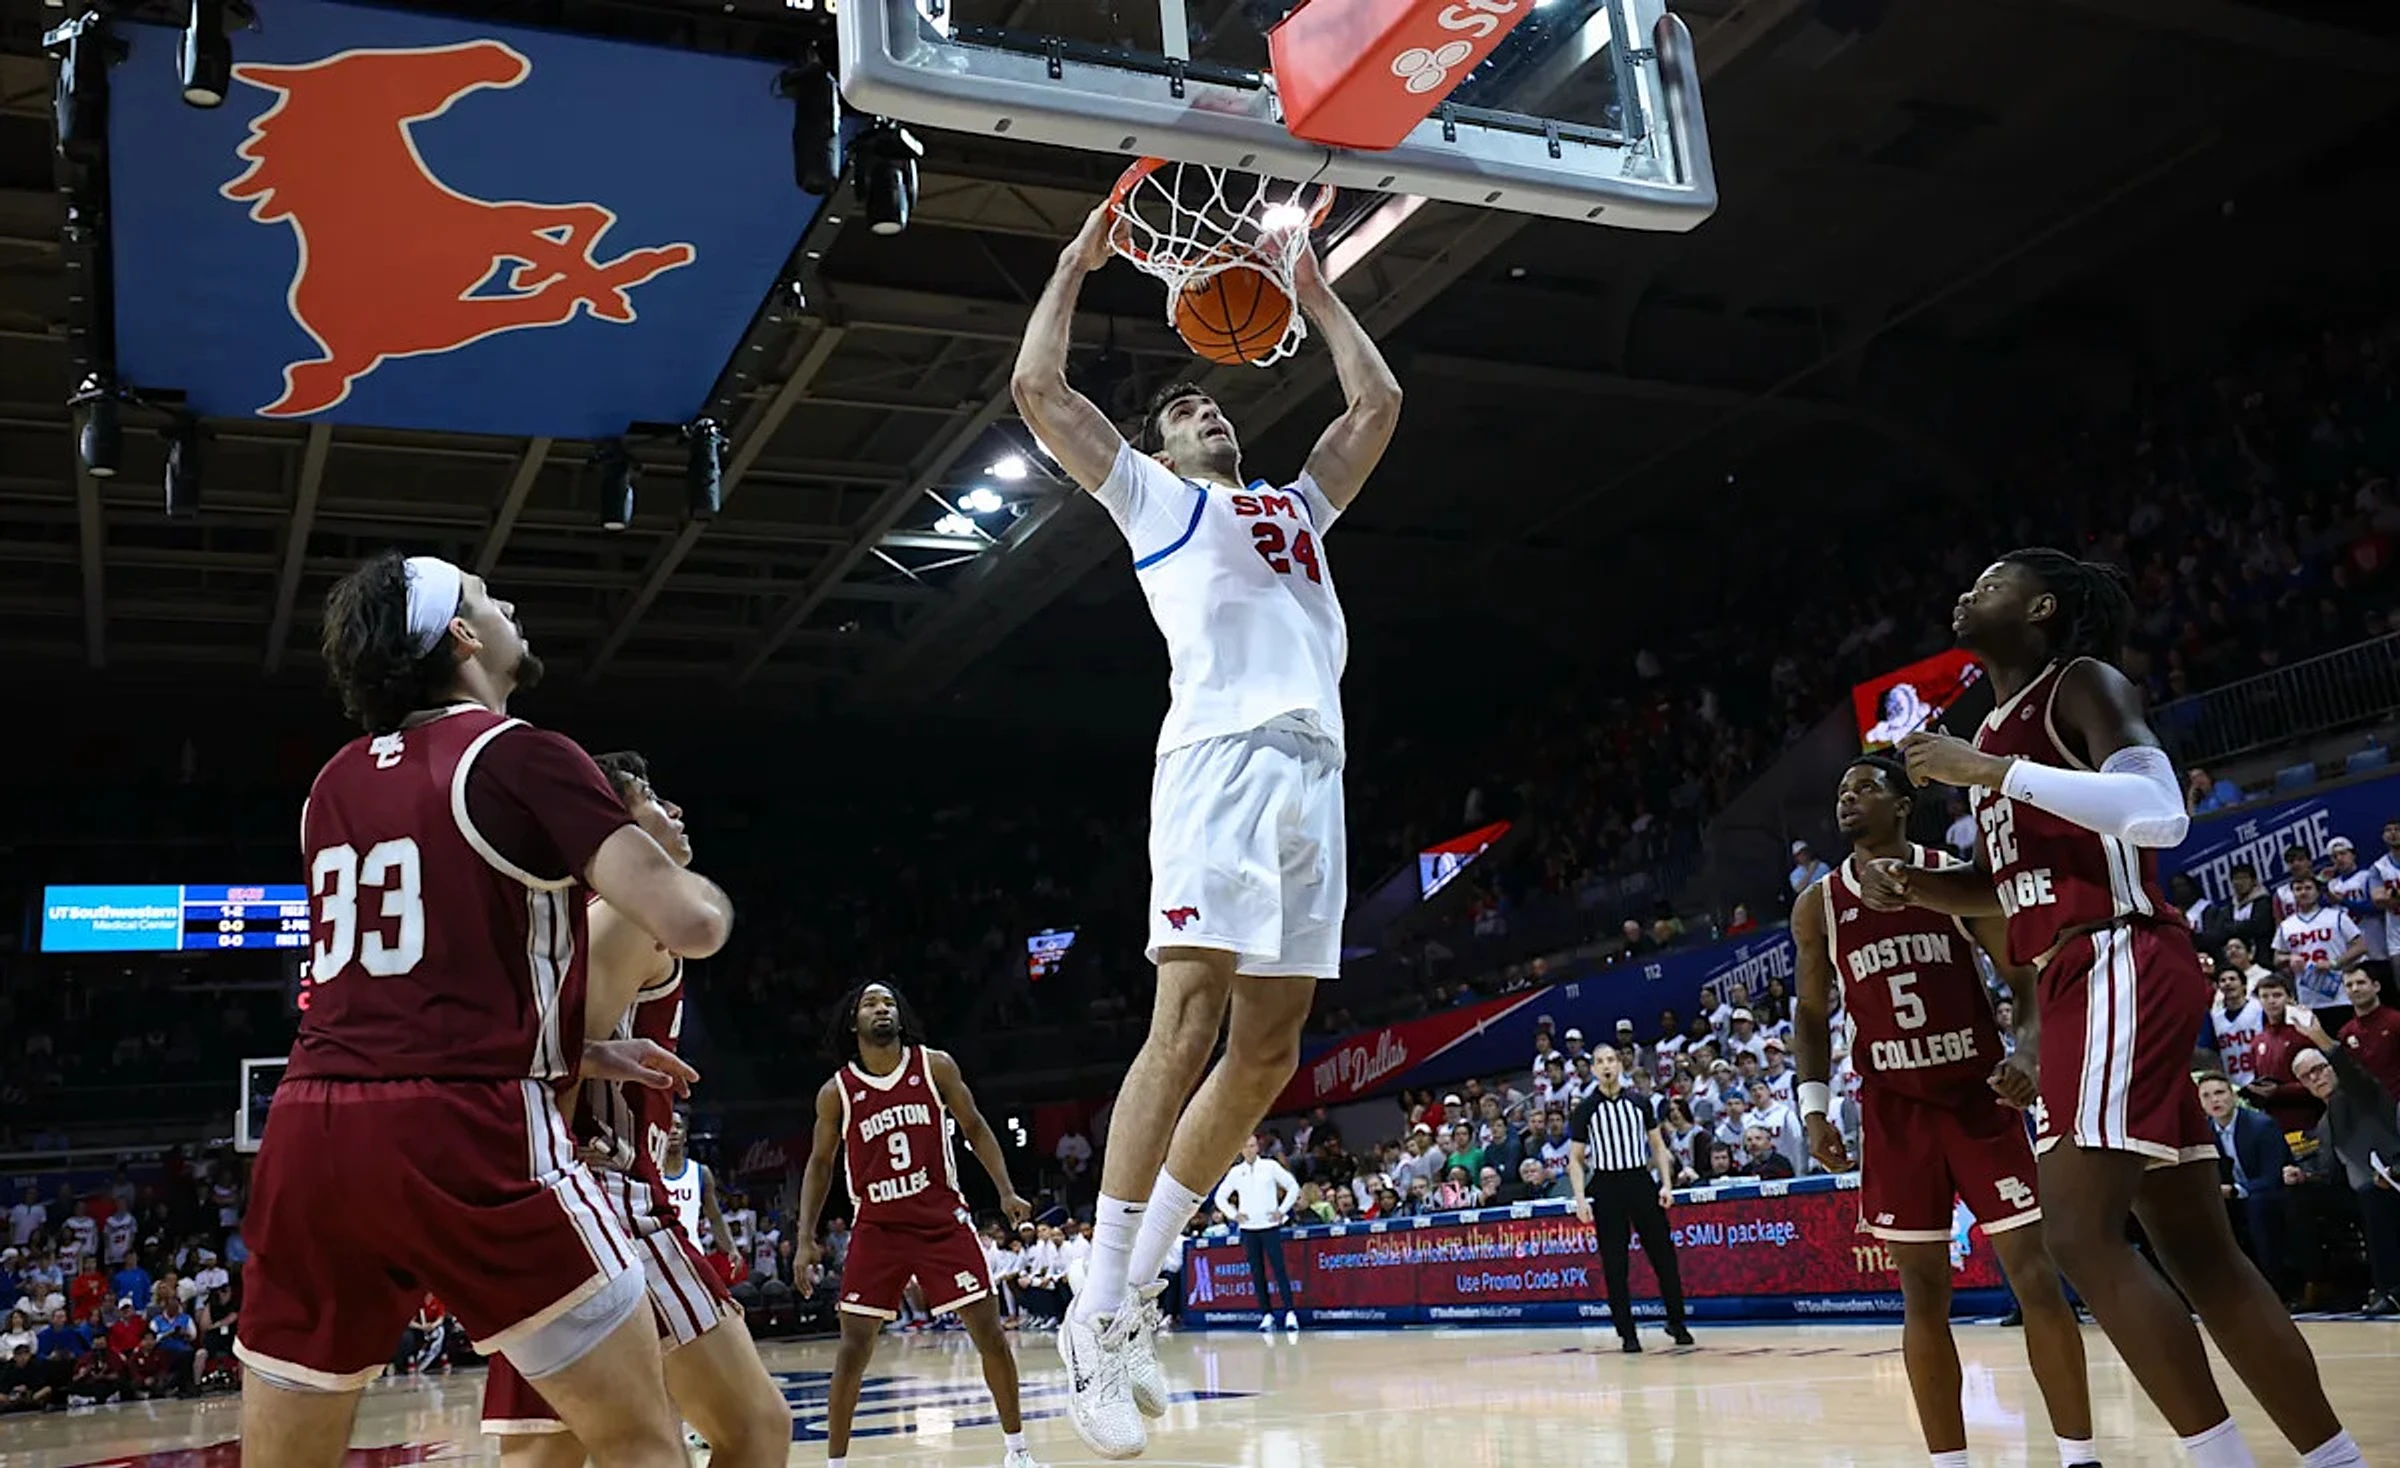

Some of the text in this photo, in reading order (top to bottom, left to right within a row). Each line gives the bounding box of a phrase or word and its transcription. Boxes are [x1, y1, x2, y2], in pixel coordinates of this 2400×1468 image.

[1231, 494, 1298, 519] SM
[1251, 521, 1321, 585] 24
[1979, 797, 2020, 875] 22
[2234, 818, 2260, 844] THE
[92, 918, 177, 931] Medical Center
[311, 836, 425, 984] 33
[1846, 932, 1953, 984] BOSTON
[2287, 927, 2332, 948] SMU
[1886, 971, 1928, 1030] 5
[1350, 1028, 1408, 1092] Dallas
[1870, 1027, 1980, 1071] COLLEGE
[859, 1104, 932, 1144] BOSTON
[887, 1131, 913, 1171] 9
[667, 1188, 692, 1201] MU
[1318, 1251, 1369, 1273] Experience
[1687, 1222, 1724, 1246] SMU
[1728, 1218, 1799, 1249] package.
[1456, 1266, 1589, 1293] Use Promo Code XPK
